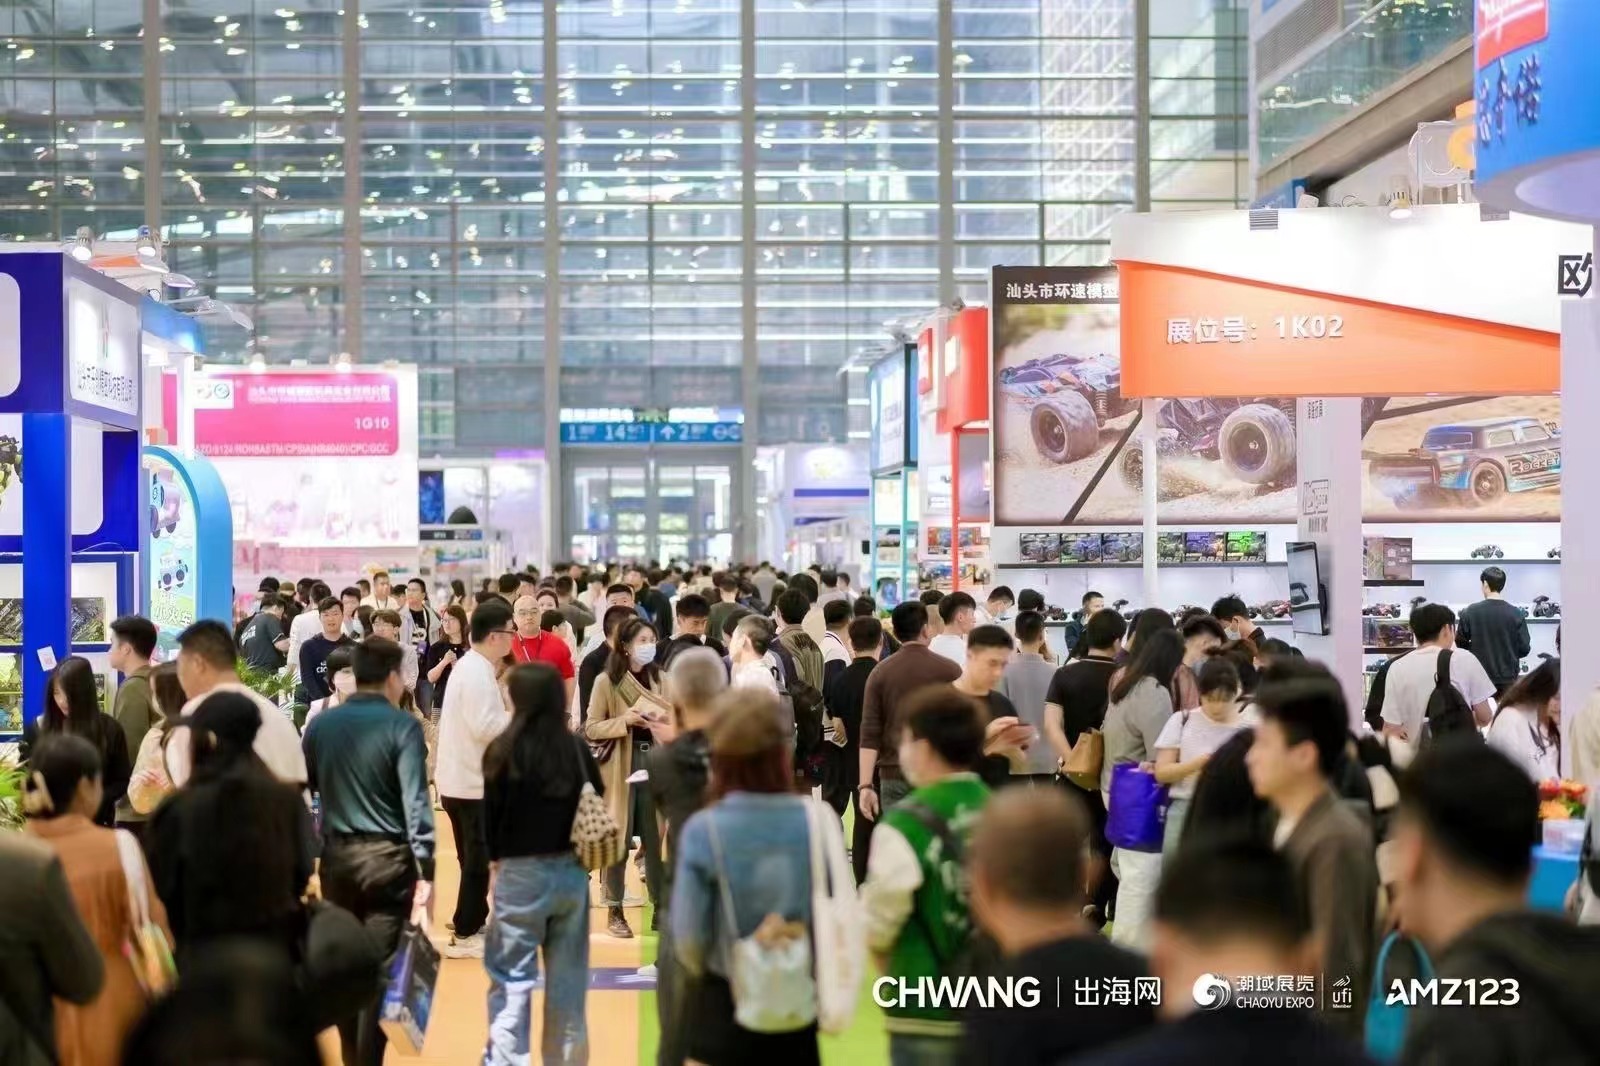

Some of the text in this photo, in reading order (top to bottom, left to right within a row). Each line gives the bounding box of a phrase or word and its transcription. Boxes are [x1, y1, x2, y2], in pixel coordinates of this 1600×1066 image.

[1006, 282, 1119, 299] 汕头市环速模型
[1275, 314, 1344, 339] 1K02
[353, 416, 390, 430] 1G10
